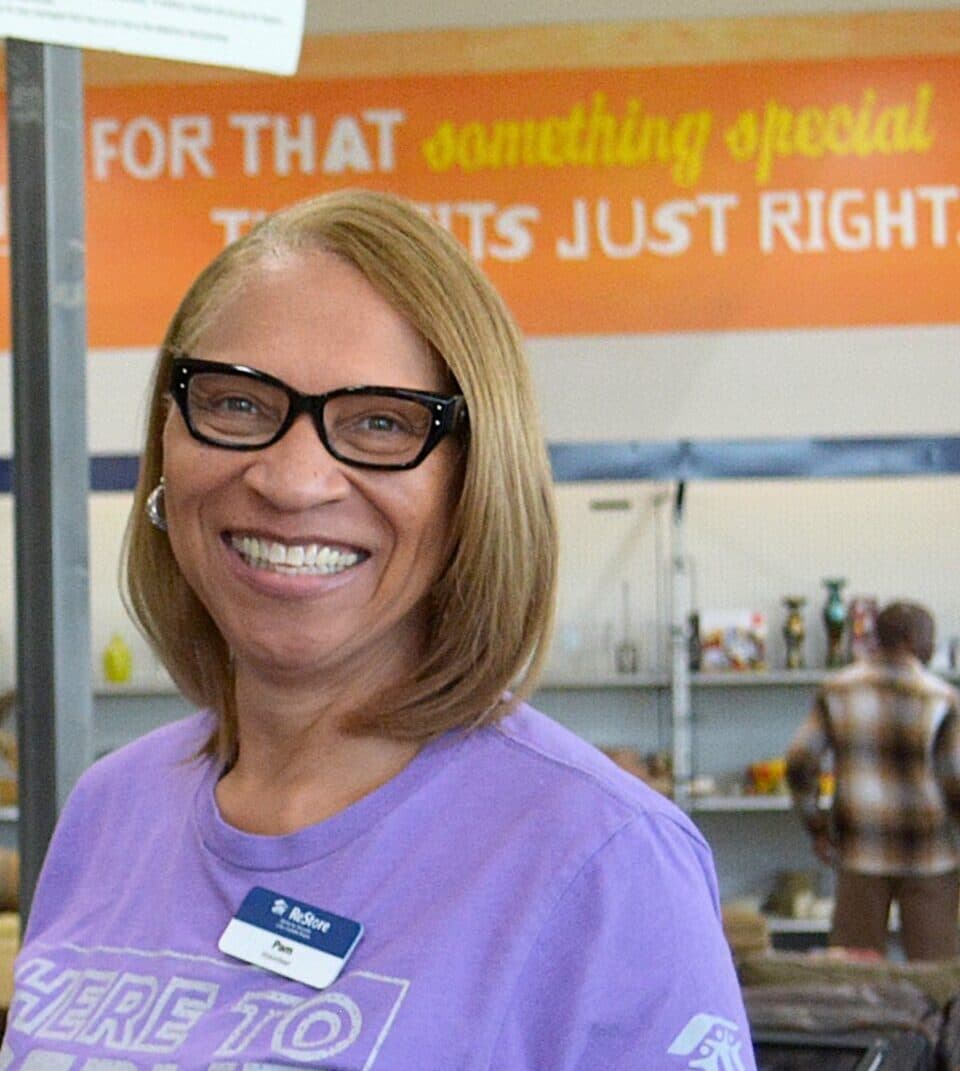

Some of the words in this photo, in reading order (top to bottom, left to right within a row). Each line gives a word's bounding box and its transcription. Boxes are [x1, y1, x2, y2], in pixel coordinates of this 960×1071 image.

[89, 114, 217, 182] FOR
[227, 108, 406, 178] THAT
[422, 91, 713, 186] something
[724, 82, 934, 184] special
[556, 194, 738, 260] JUST
[272, 939, 293, 955] Pam
[288, 906, 331, 933] ReStore
[12, 957, 221, 1054] HERE
[213, 989, 364, 1063] TO
